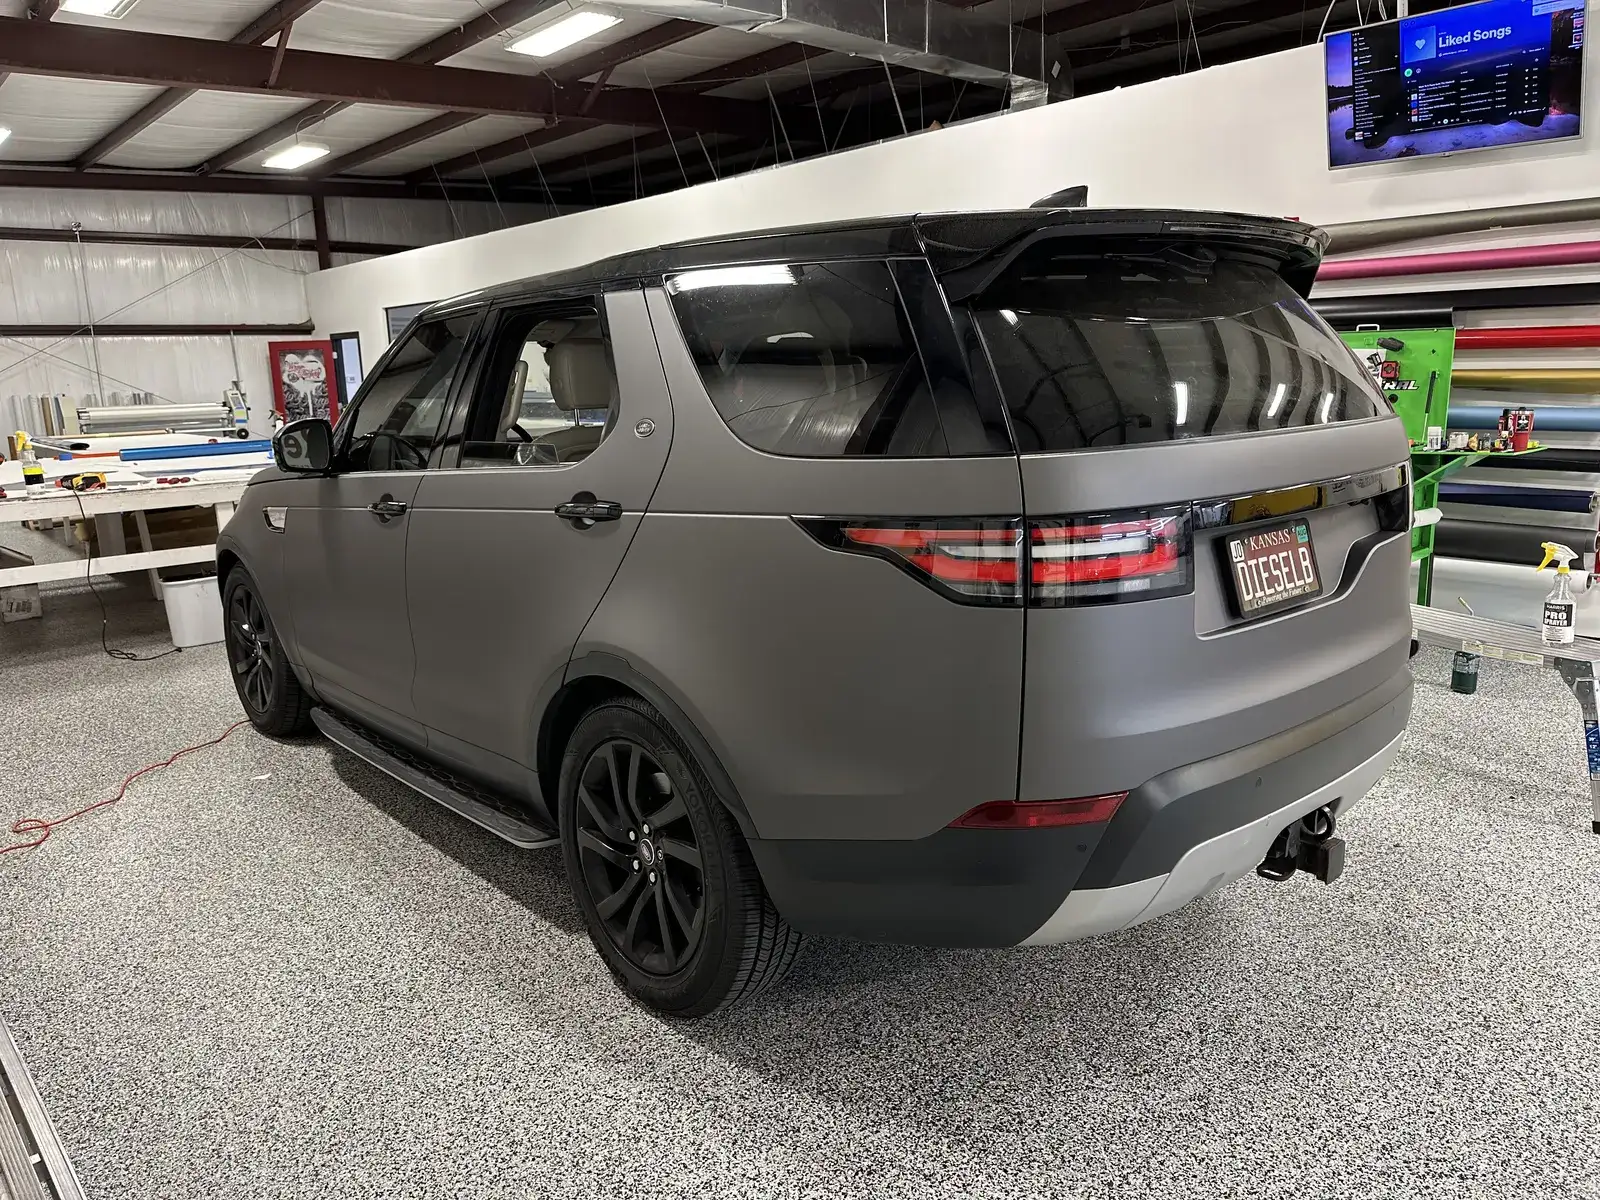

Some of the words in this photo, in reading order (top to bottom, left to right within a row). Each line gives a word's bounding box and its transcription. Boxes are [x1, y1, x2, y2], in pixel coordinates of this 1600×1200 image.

[1438, 31, 1471, 48] Liked
[1473, 26, 1512, 41] Songs
[1249, 528, 1291, 551] KANSAS
[1233, 542, 1243, 559] JO
[1237, 547, 1314, 601] DIESELB
[1544, 618, 1568, 626] SPRAYER
[1545, 610, 1567, 620] PRO
